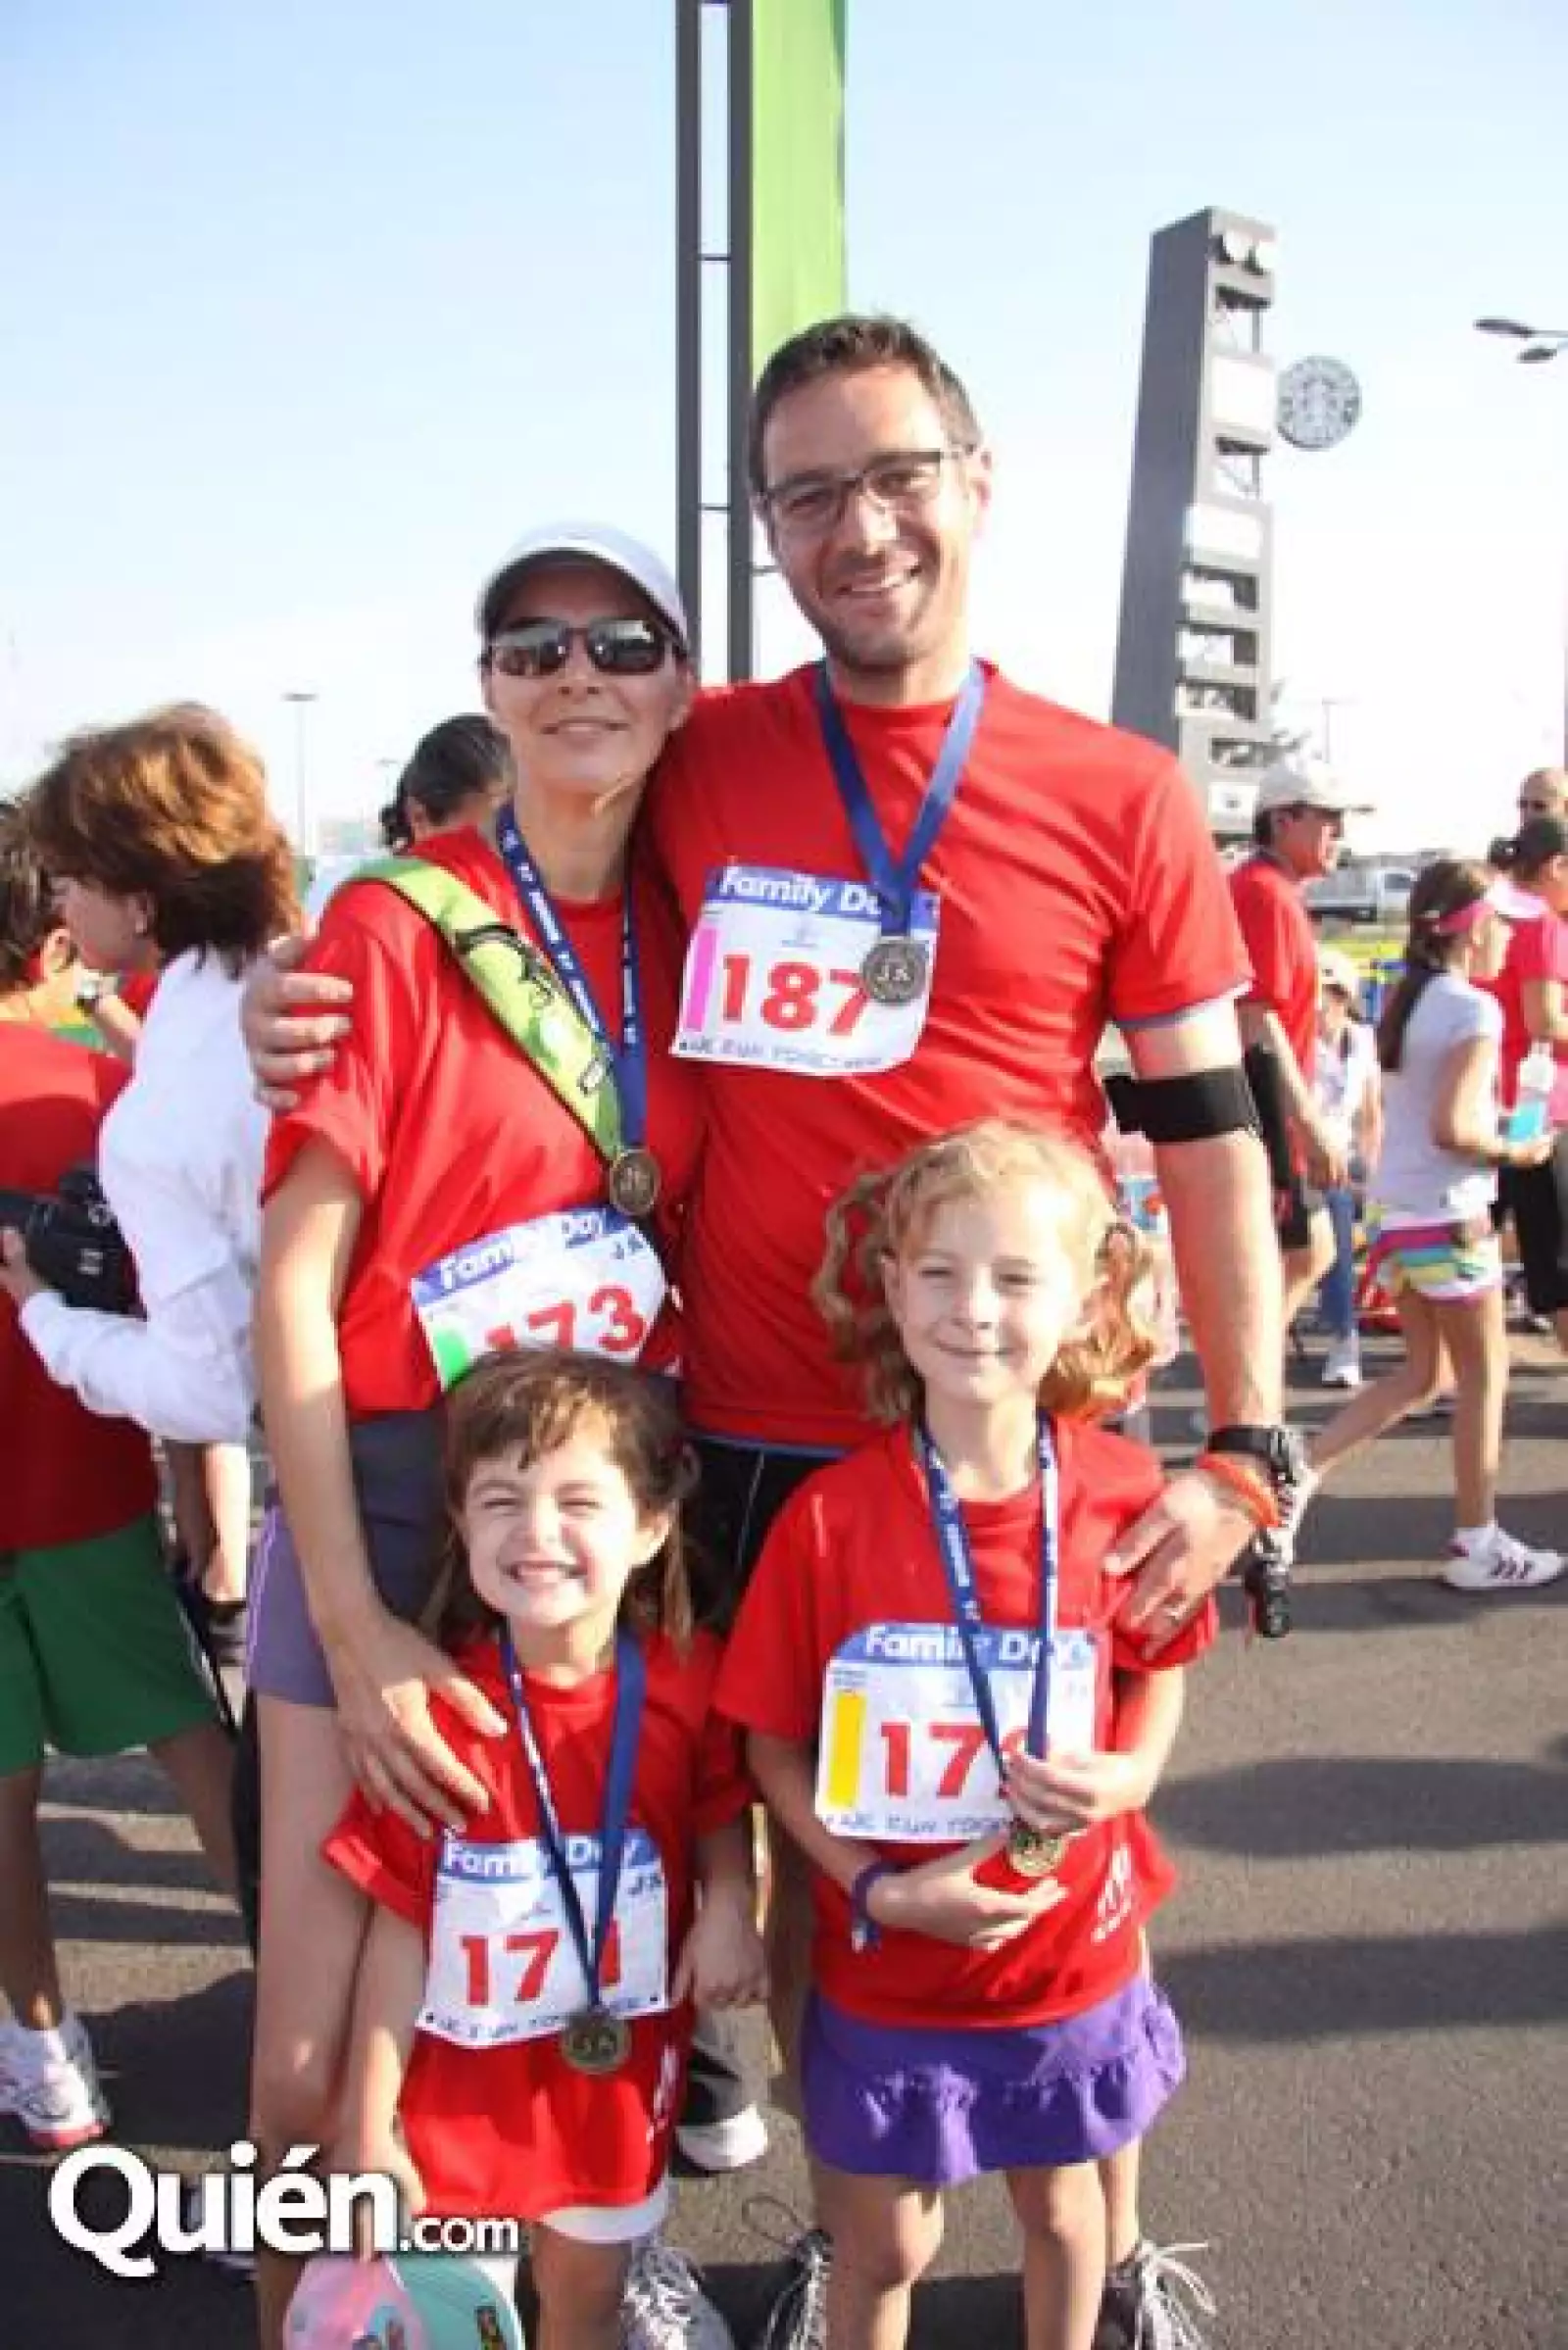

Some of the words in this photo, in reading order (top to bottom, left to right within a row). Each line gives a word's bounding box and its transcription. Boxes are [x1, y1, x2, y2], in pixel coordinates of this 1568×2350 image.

[720, 866, 833, 912] Family
[723, 955, 869, 1036] 187
[881, 1723, 1028, 1800] 17
